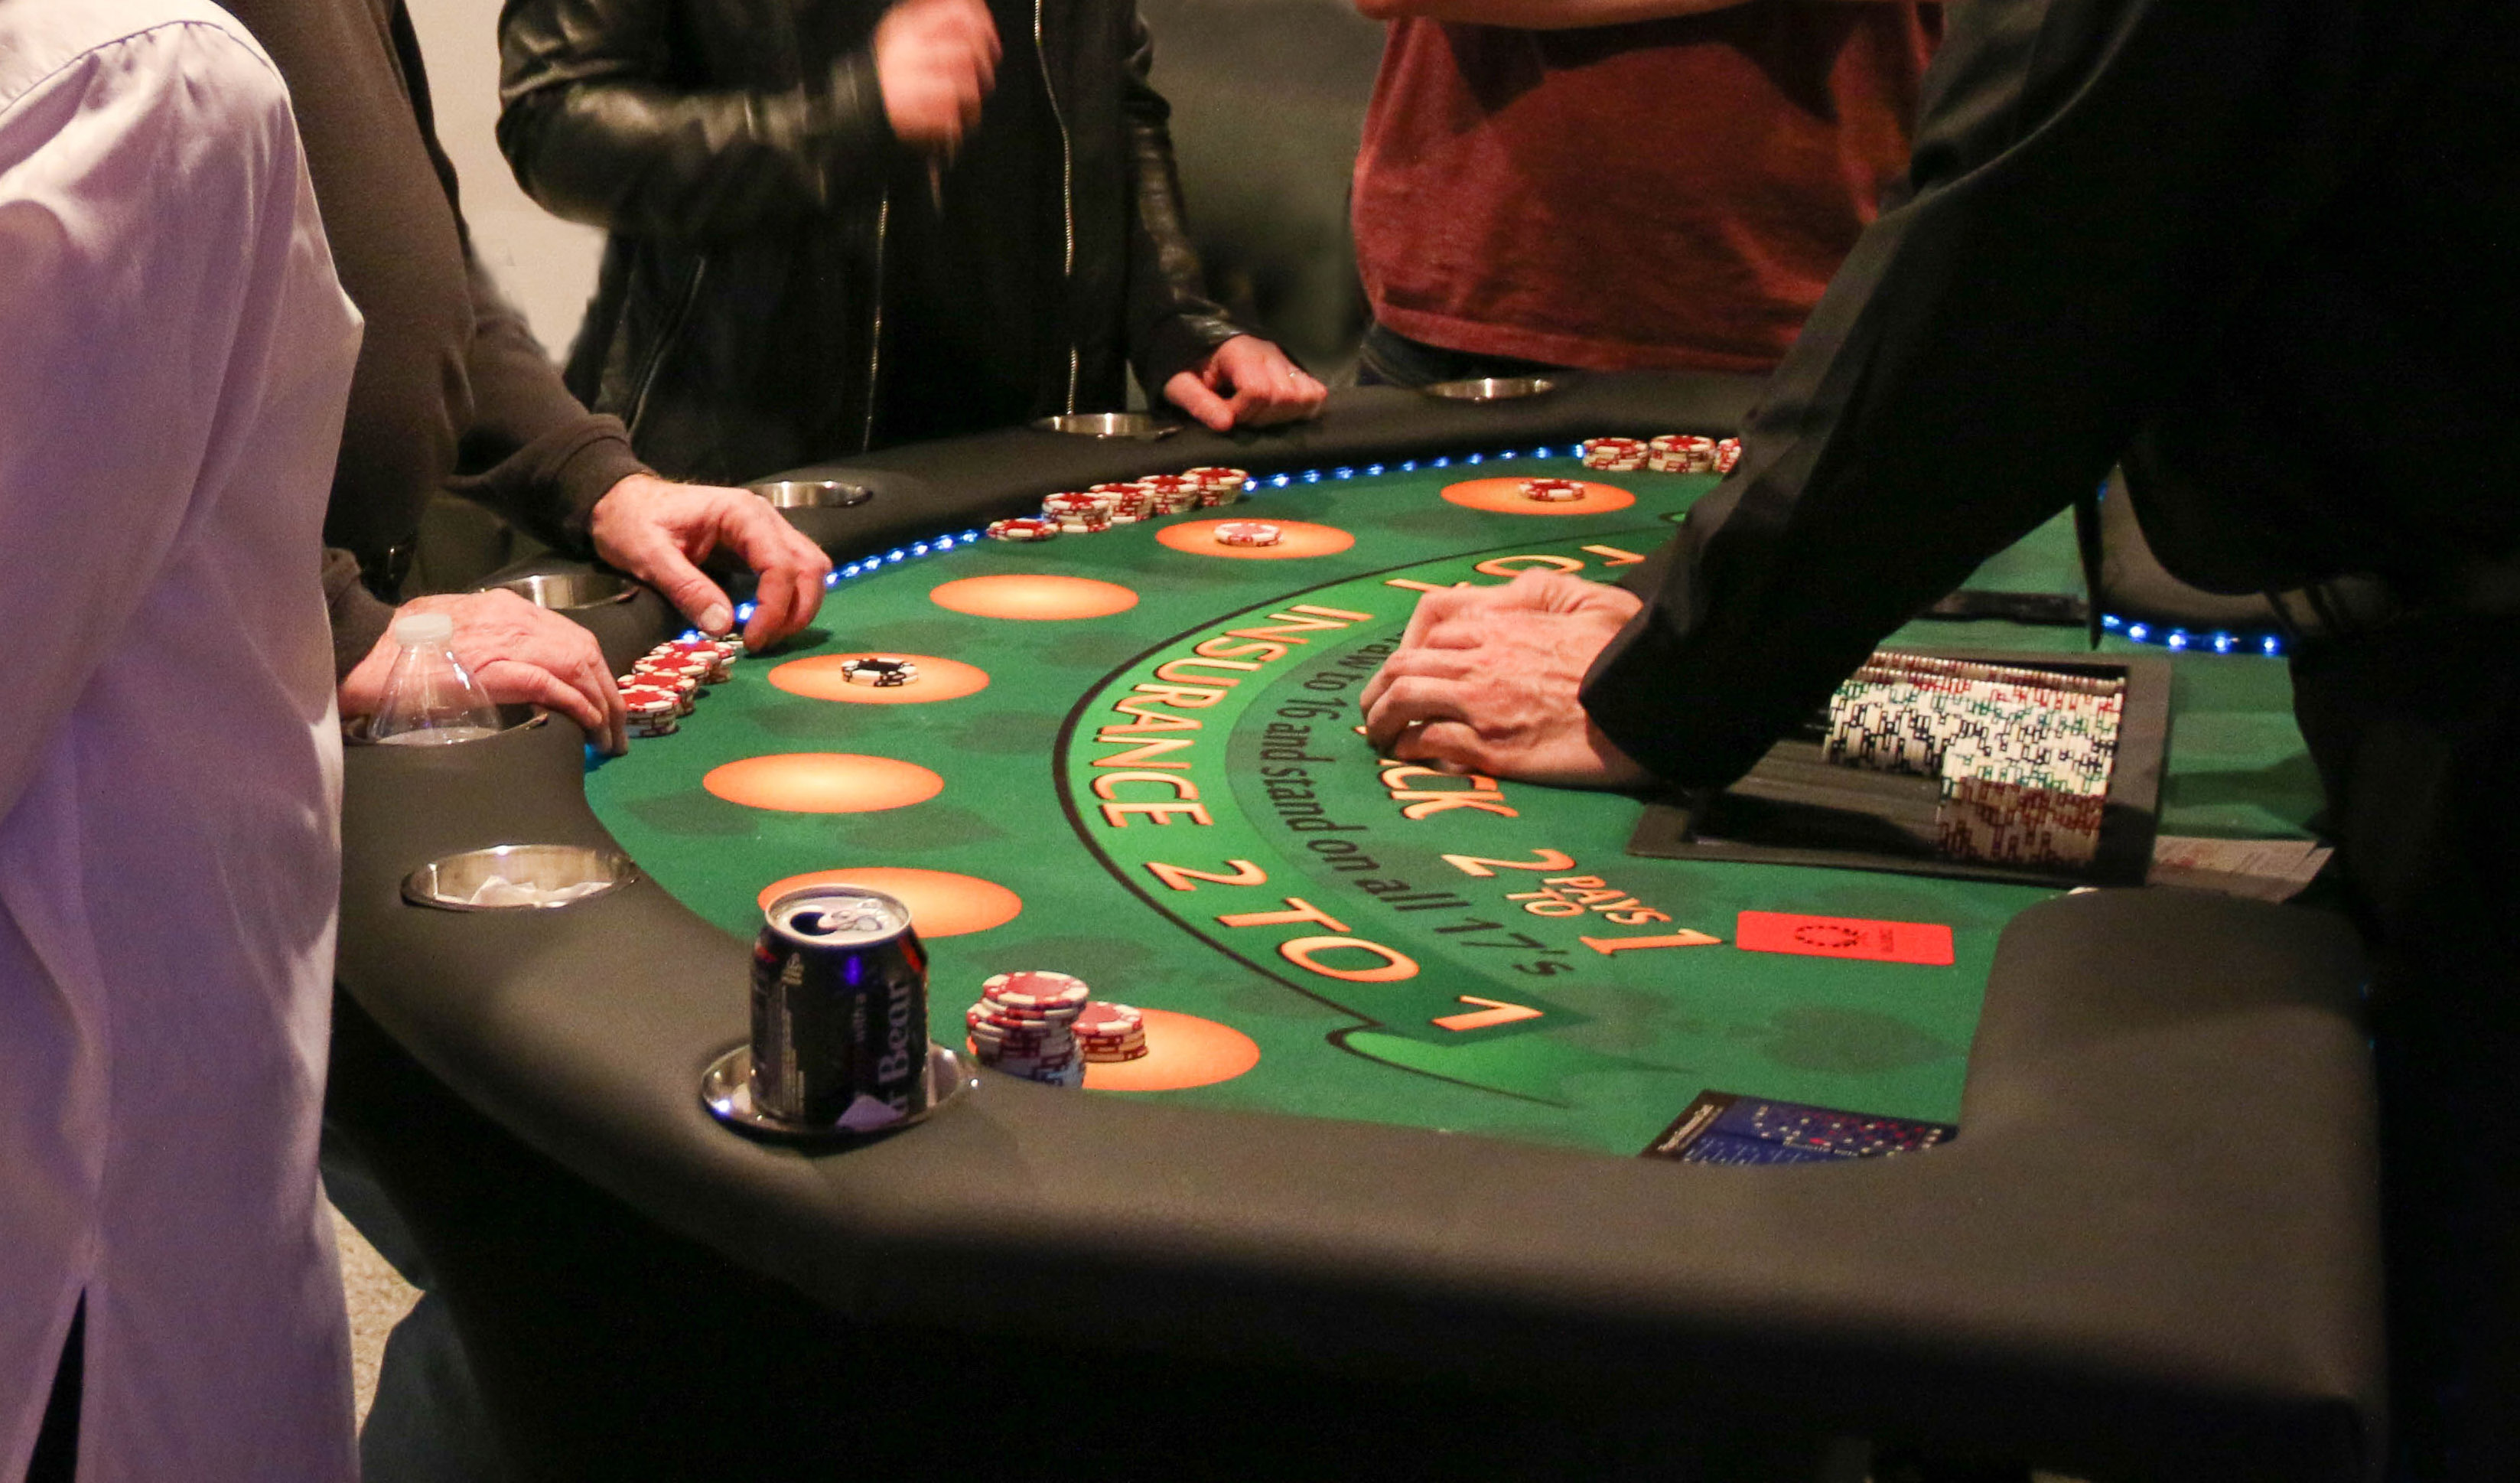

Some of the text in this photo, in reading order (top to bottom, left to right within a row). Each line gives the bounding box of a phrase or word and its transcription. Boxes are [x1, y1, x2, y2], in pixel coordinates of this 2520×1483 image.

[1303, 671, 1365, 692] to
[1090, 604, 1375, 828] INSURANCE
[1277, 696, 1349, 721] 16
[1259, 722, 1337, 762] and
[1261, 767, 1369, 832] stand
[1306, 839, 1380, 872] on
[1441, 848, 1577, 878] 2
[1143, 859, 1268, 891] 2
[1356, 879, 1471, 911] all
[1504, 887, 1586, 918] TO
[1542, 875, 1673, 926] PAYS
[1215, 897, 1420, 983] TO
[1433, 916, 1574, 976] 17's
[1577, 927, 1723, 956] 1
[1431, 995, 1544, 1032] 1
